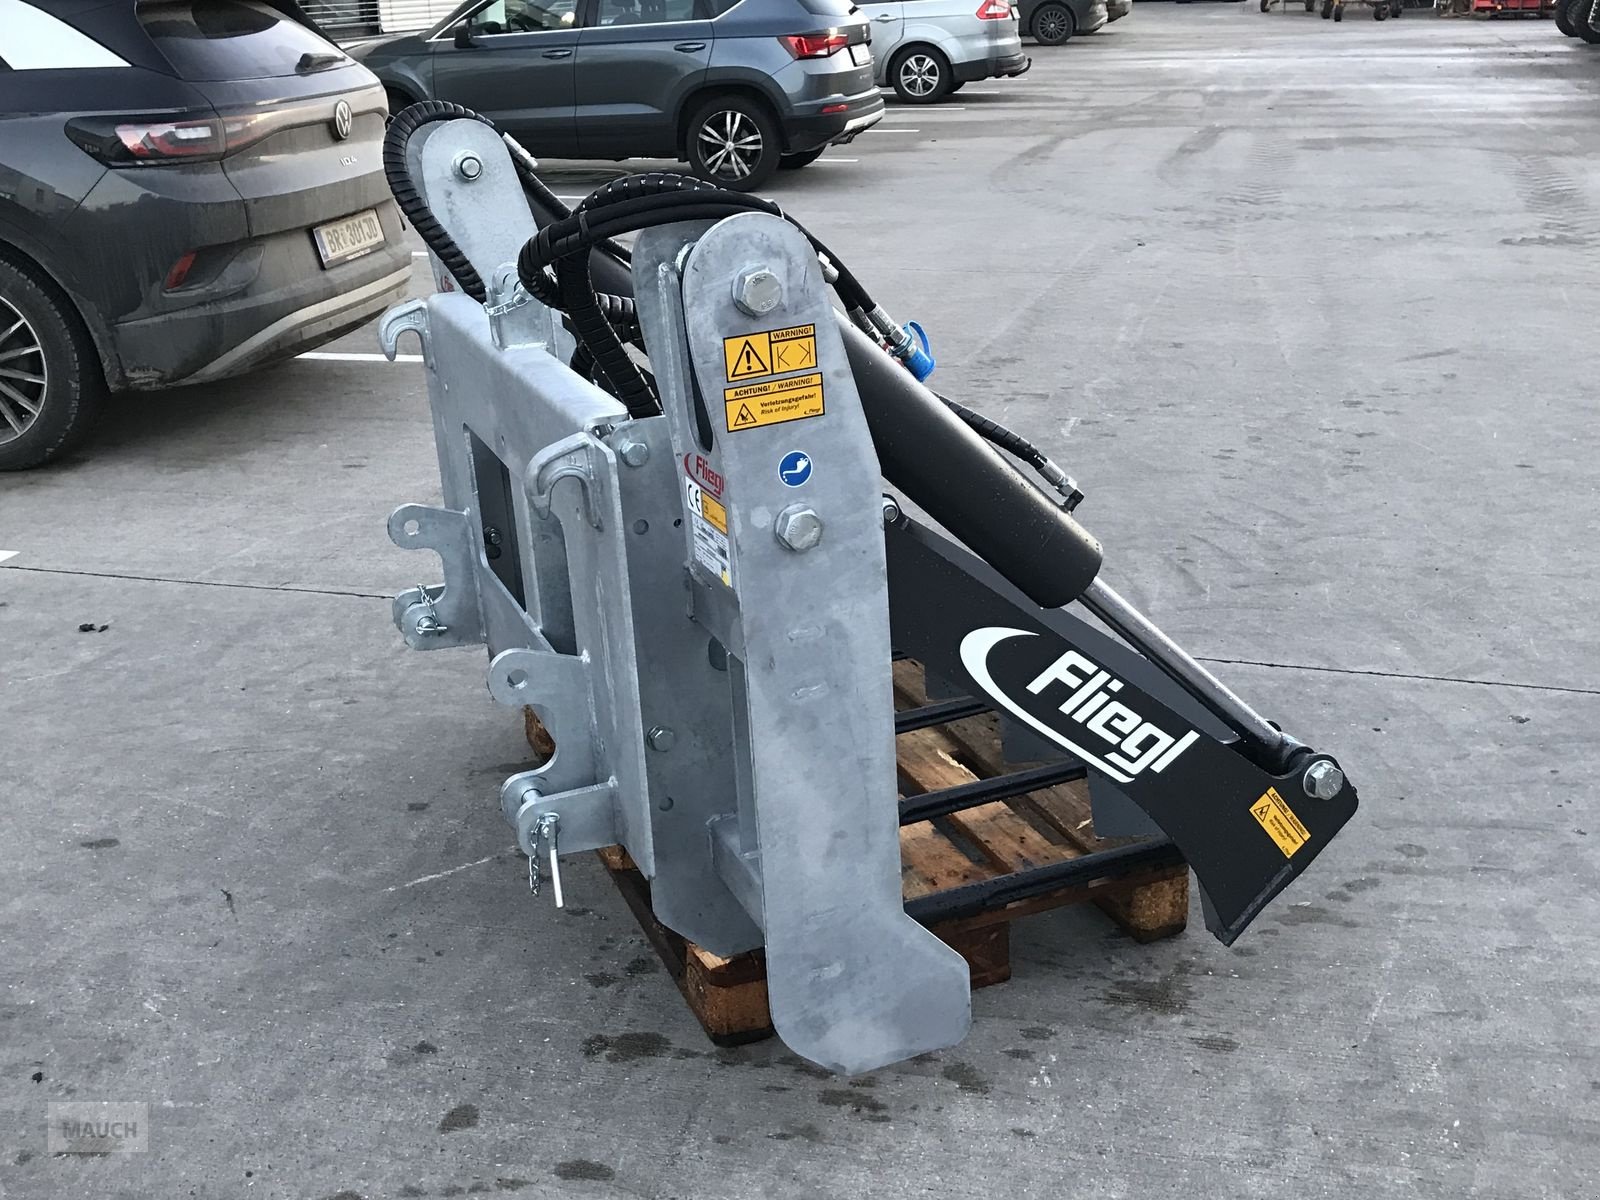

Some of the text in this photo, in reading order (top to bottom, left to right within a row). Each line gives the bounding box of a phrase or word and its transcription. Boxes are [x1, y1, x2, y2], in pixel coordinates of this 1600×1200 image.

[325, 228, 344, 253] BR
[773, 327, 812, 340] WARNING!
[734, 384, 771, 397] ACHTUNG!
[778, 378, 813, 389] WARNING!
[760, 393, 817, 408] Verletzungsgefahr!
[761, 407, 773, 415] Risk
[696, 455, 725, 496] Fliegl
[688, 484, 701, 513] CE
[1025, 650, 1200, 774] Fliegl
